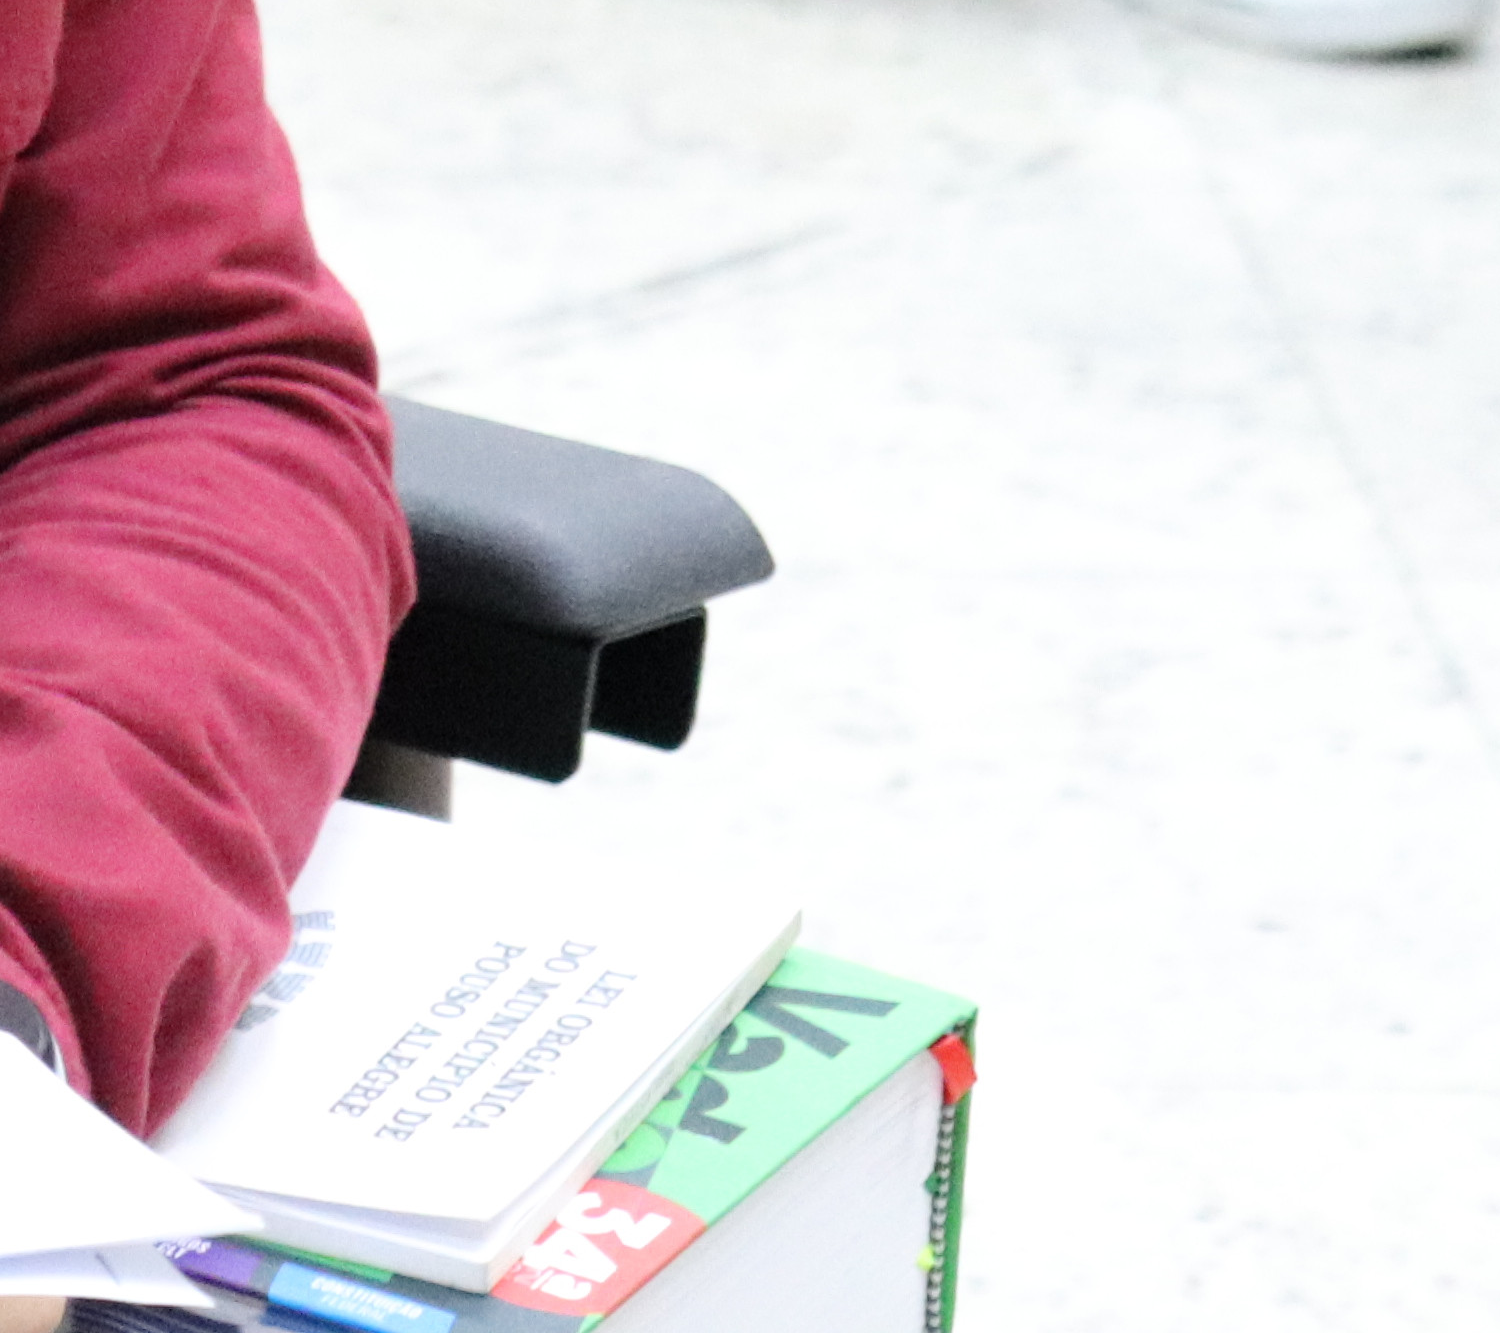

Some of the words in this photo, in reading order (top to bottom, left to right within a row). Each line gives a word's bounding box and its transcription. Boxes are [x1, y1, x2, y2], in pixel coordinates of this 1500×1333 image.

[430, 940, 527, 1019] POUSO
[544, 939, 597, 973] DO
[575, 969, 638, 1009] LEI
[415, 977, 561, 1103] MUNICÍPIO
[329, 1022, 442, 1118] ALEGRE
[374, 1108, 432, 1142] DE
